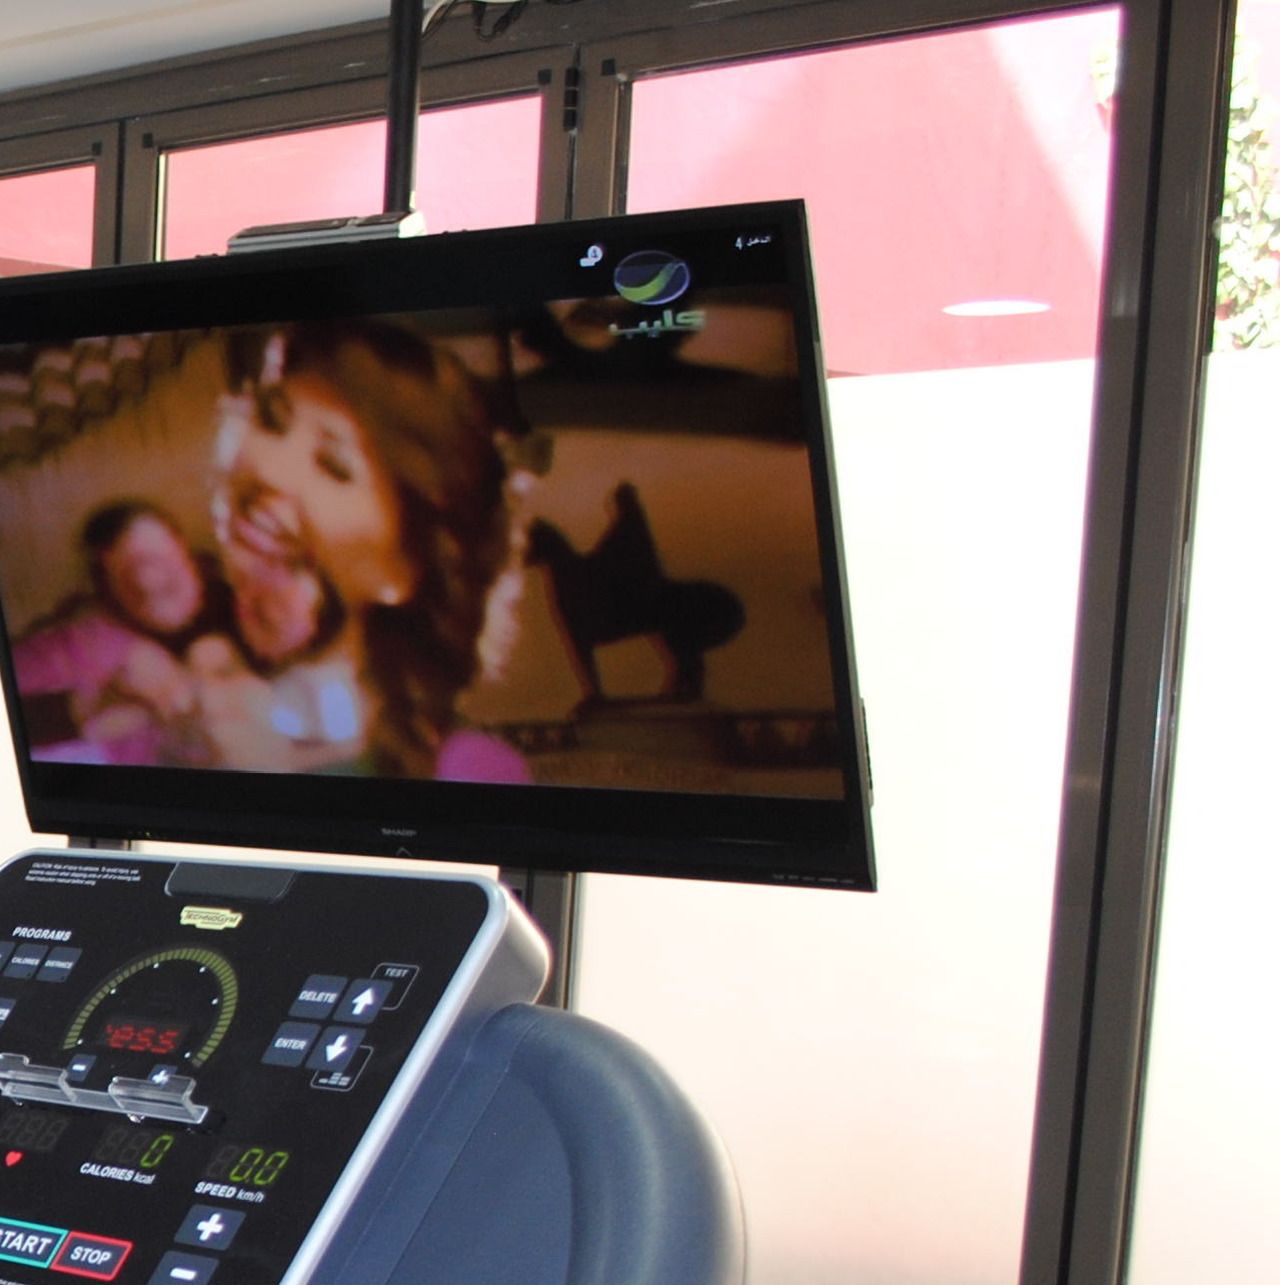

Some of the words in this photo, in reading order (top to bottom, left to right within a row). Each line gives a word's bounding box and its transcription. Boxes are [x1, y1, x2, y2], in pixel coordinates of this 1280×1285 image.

[12, 926, 72, 942] PROGRAMS
[384, 968, 409, 978] TEST
[298, 990, 337, 1004] DELETE
[274, 1038, 307, 1050] ENTER
[140, 1135, 174, 1168] 0
[80, 1162, 133, 1182] CALORIES
[134, 1172, 156, 1185] kcal
[195, 1181, 236, 1199] SPEED
[236, 1189, 265, 1203] km/h
[70, 1245, 112, 1265] STOP
